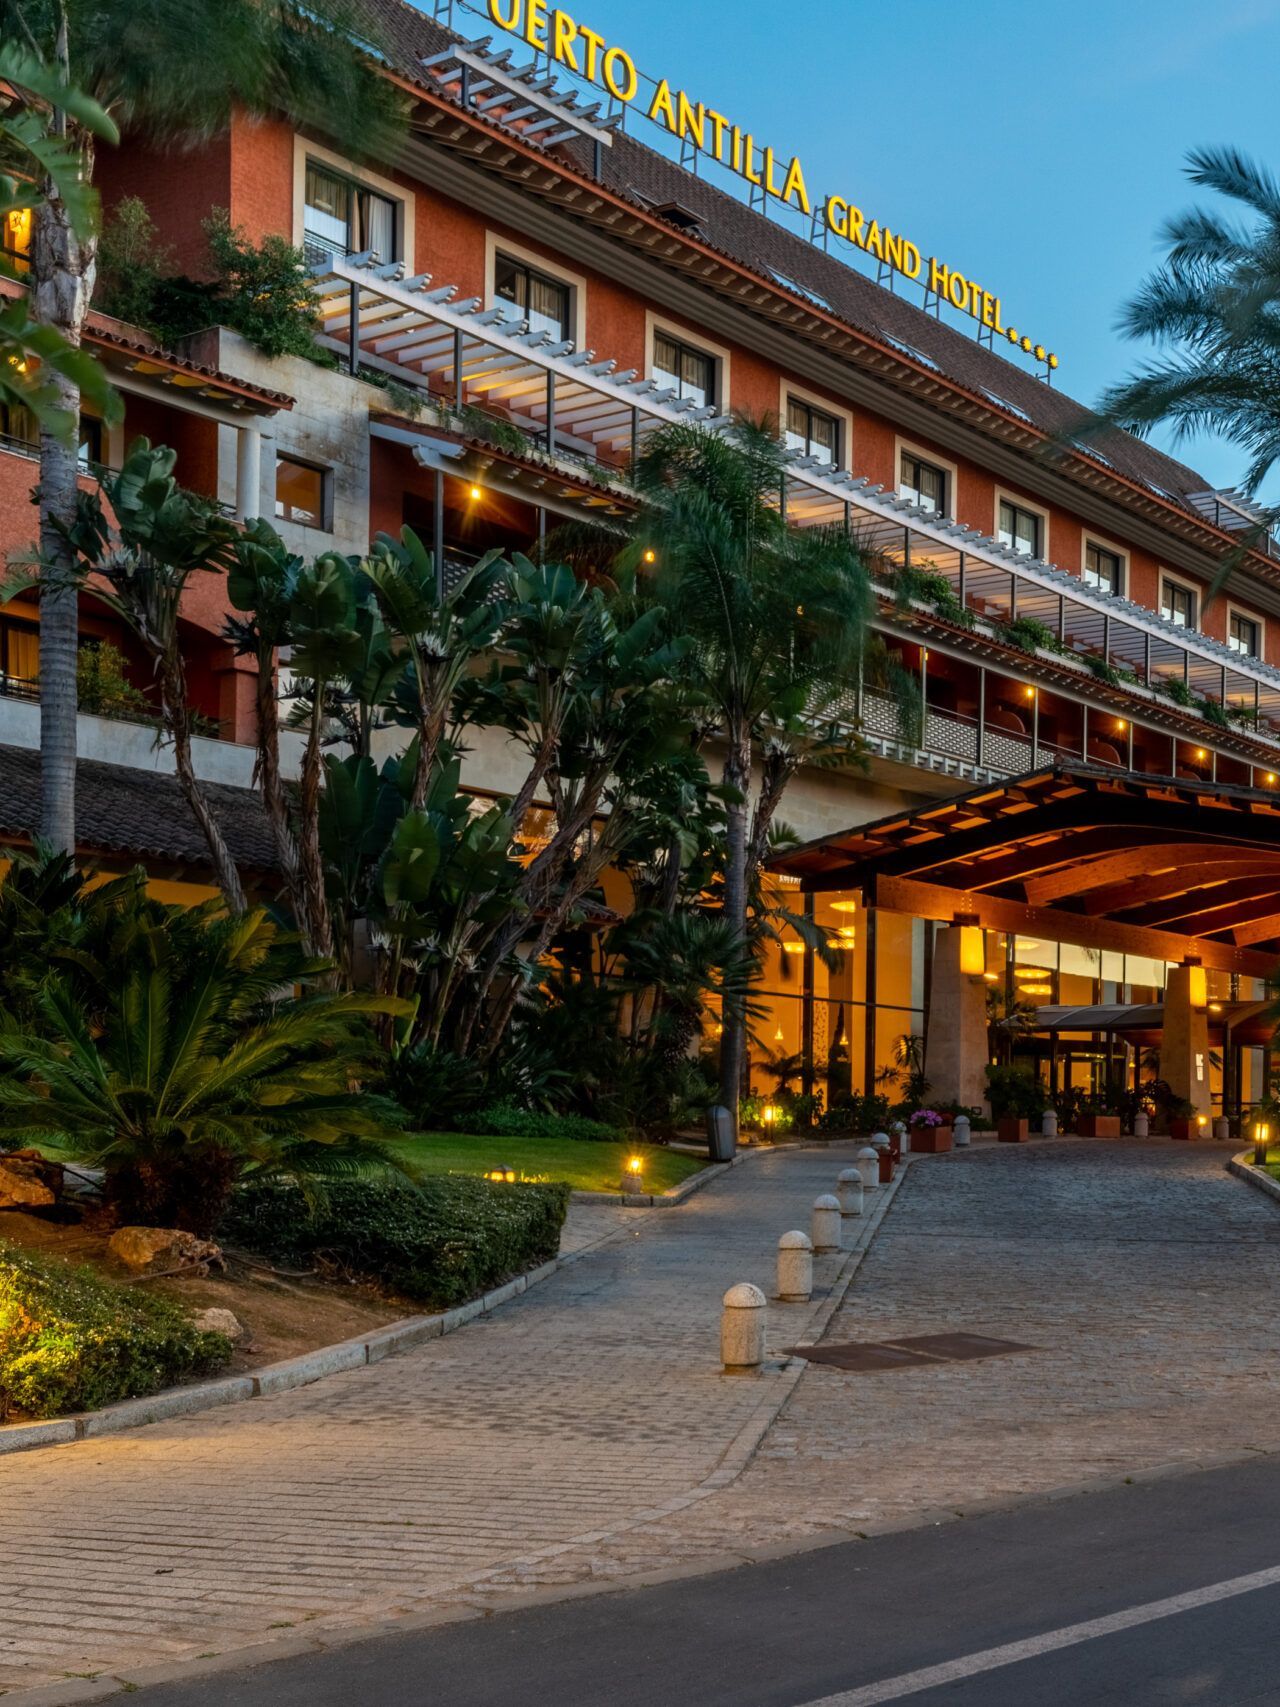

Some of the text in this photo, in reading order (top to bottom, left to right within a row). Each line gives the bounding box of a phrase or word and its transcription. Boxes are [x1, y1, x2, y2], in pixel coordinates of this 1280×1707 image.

[650, 79, 810, 214] ANTILLA
[827, 196, 921, 279] GRAND
[930, 257, 1005, 334] HOTEL
